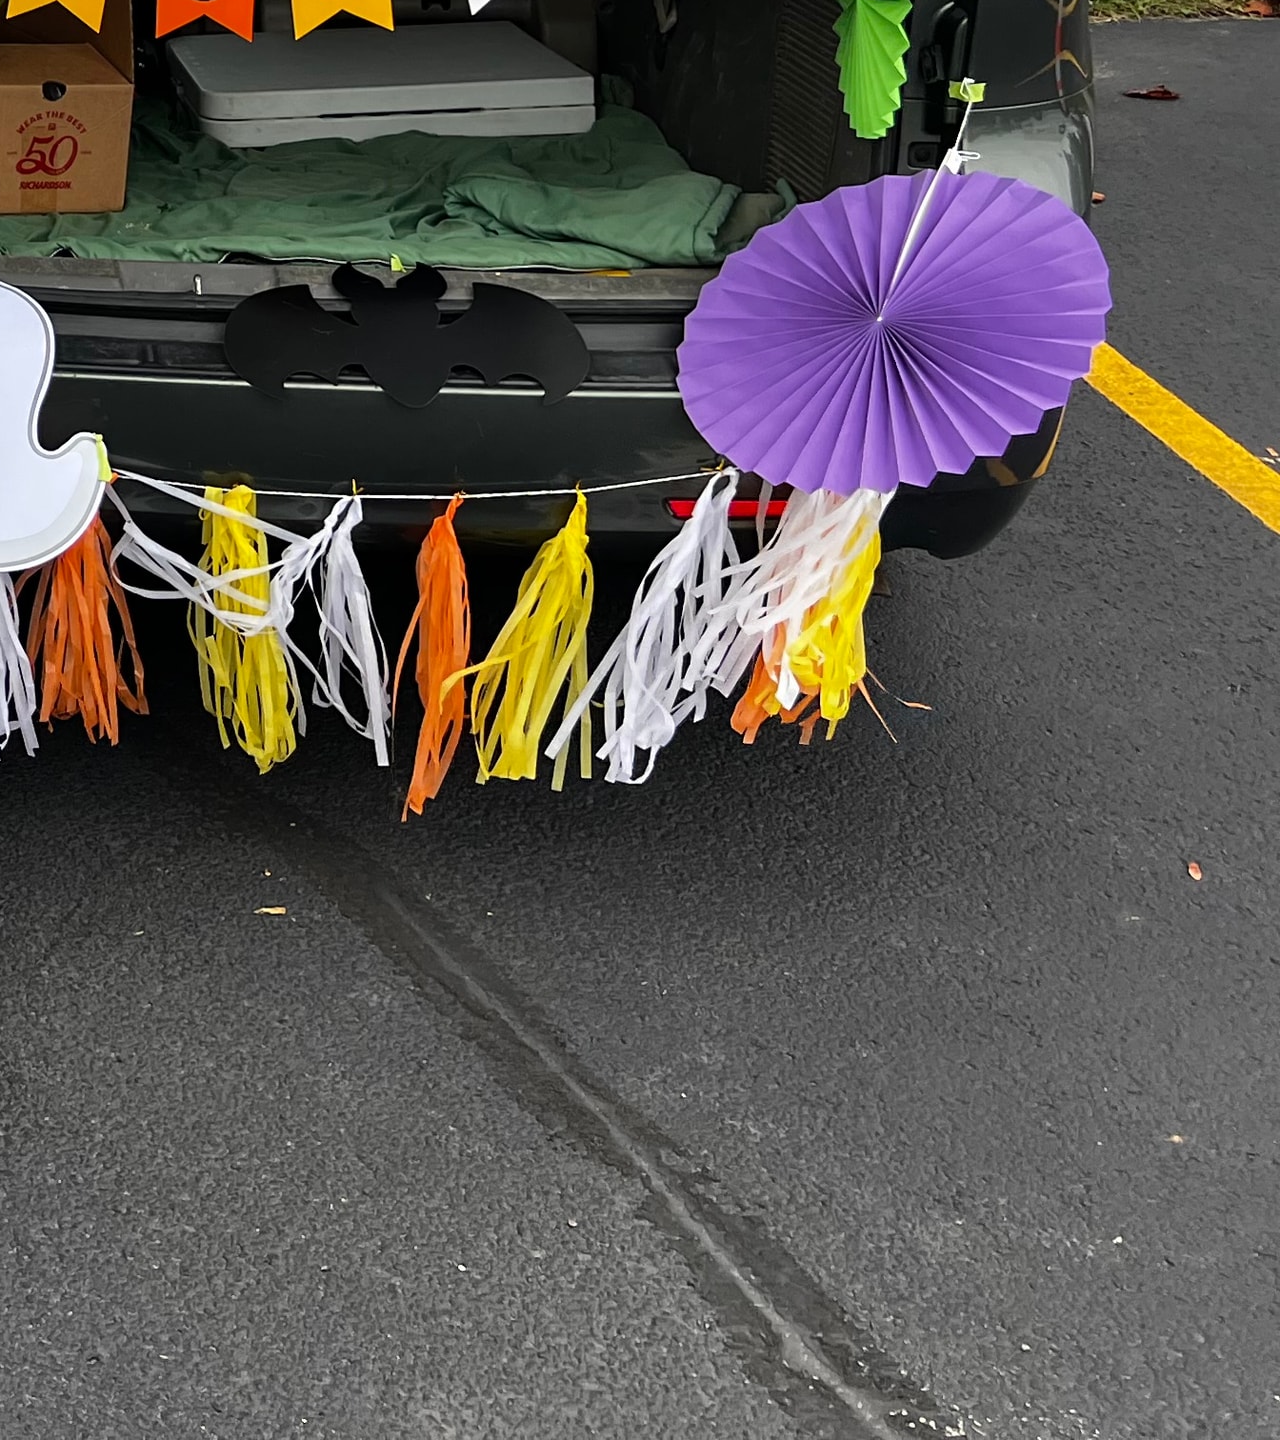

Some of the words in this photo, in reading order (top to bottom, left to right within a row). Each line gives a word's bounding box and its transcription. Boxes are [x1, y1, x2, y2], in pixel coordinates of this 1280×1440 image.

[15, 112, 43, 134] WEAR
[45, 110, 65, 120] THE
[66, 114, 88, 135] BEST
[15, 135, 79, 177] 50
[19, 181, 73, 190] RICHARDSON
